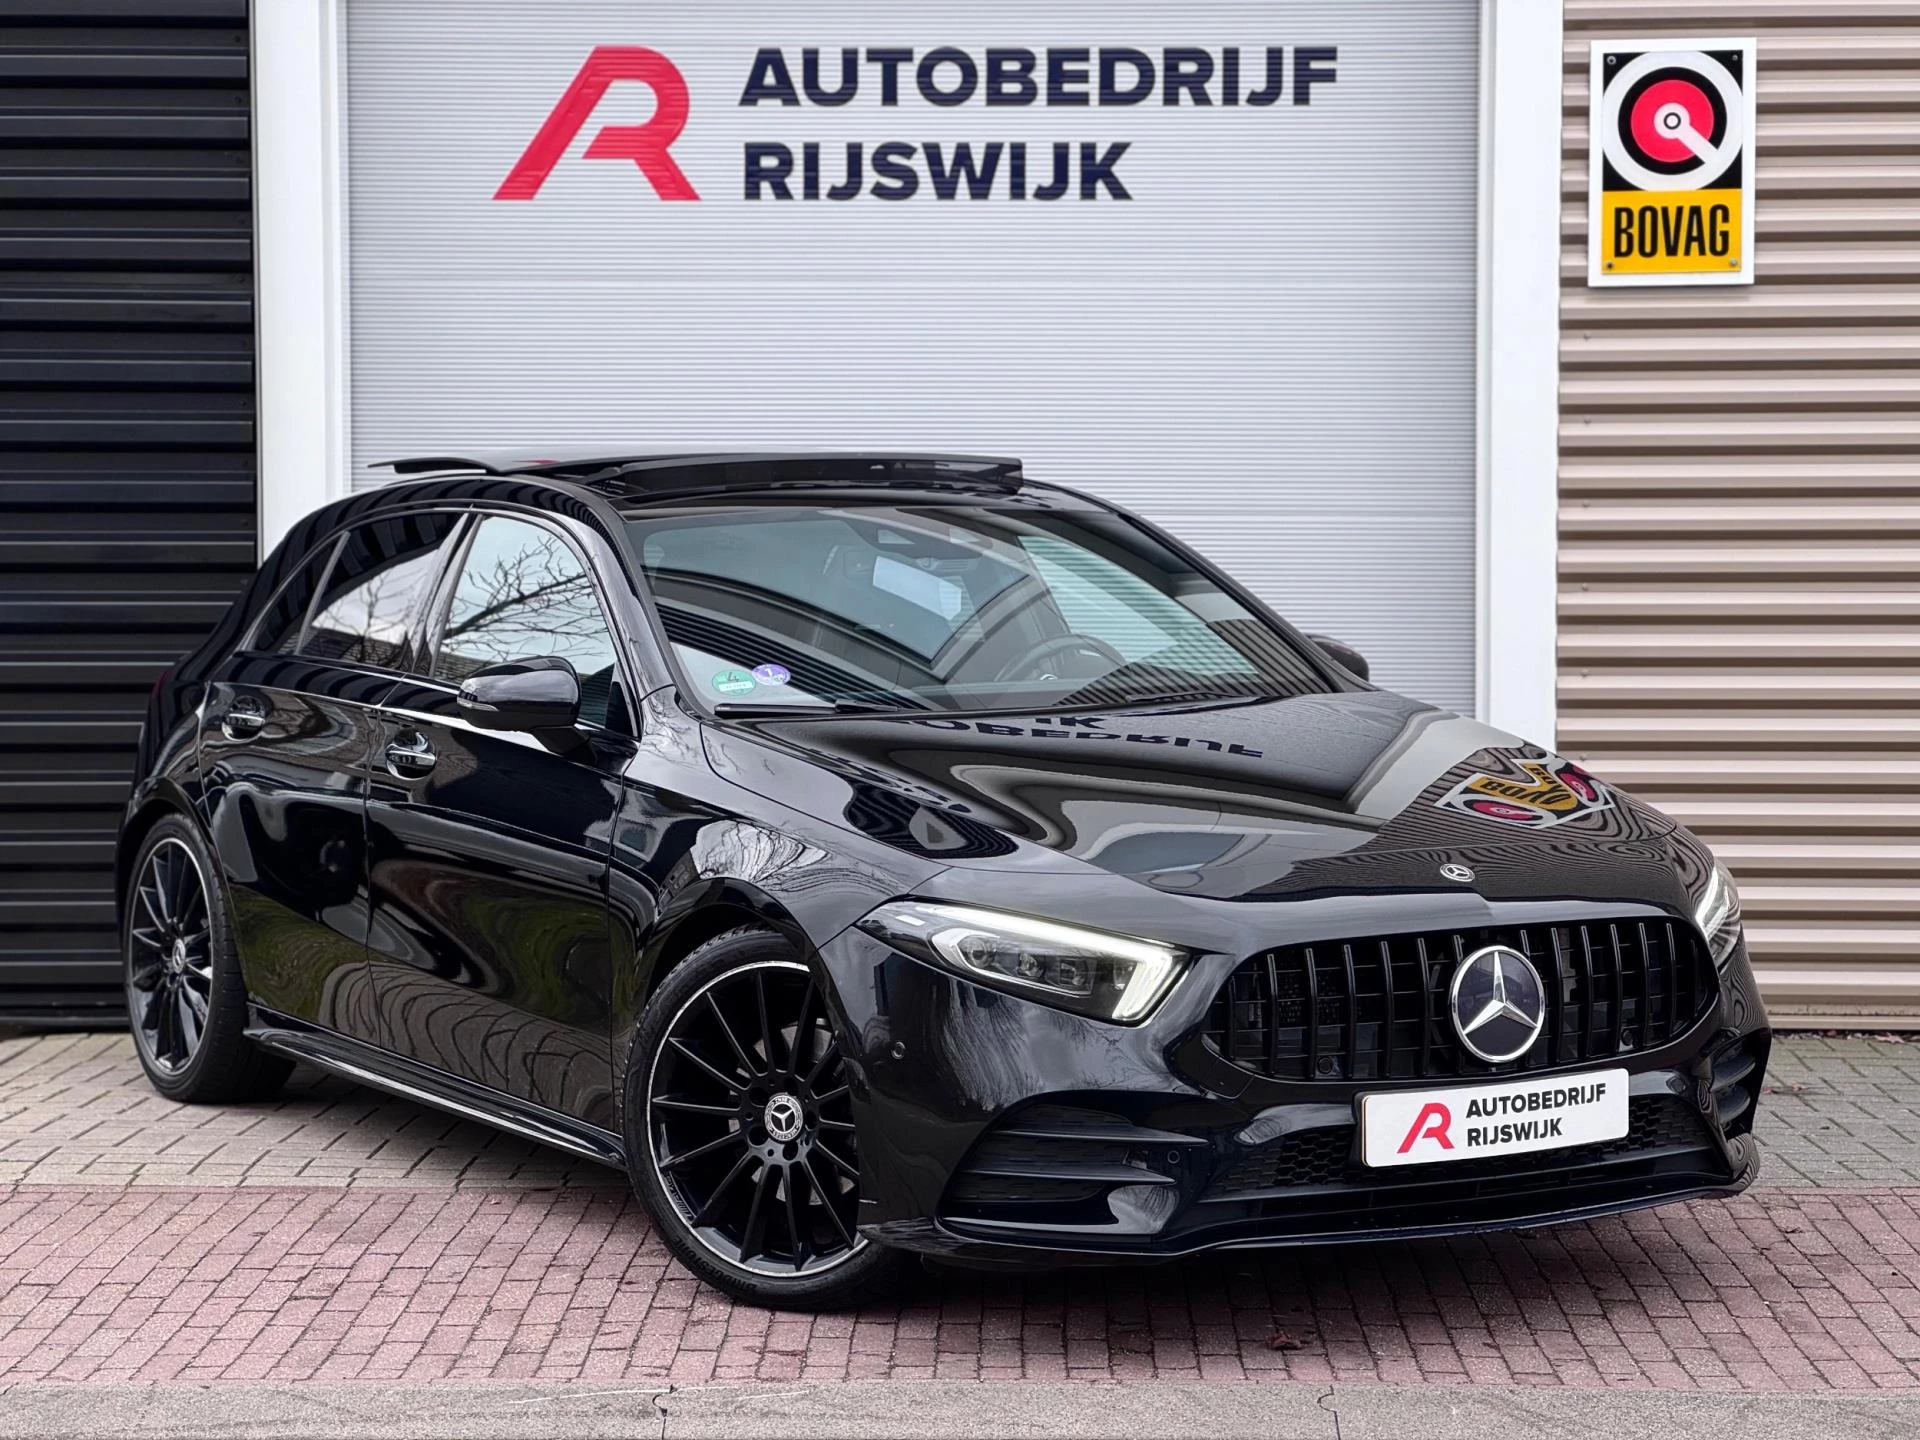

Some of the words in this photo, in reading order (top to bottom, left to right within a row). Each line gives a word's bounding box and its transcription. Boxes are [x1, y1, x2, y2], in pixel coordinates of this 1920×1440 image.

[740, 47, 1337, 106] AUTOBEDRIJF
[745, 142, 1131, 200] RIJSWIJK
[1614, 204, 1730, 258] BOVAG
[1466, 1083, 1606, 1118] AUTOBEDRIJF
[1467, 1117, 1562, 1147] RIJSWIJK
